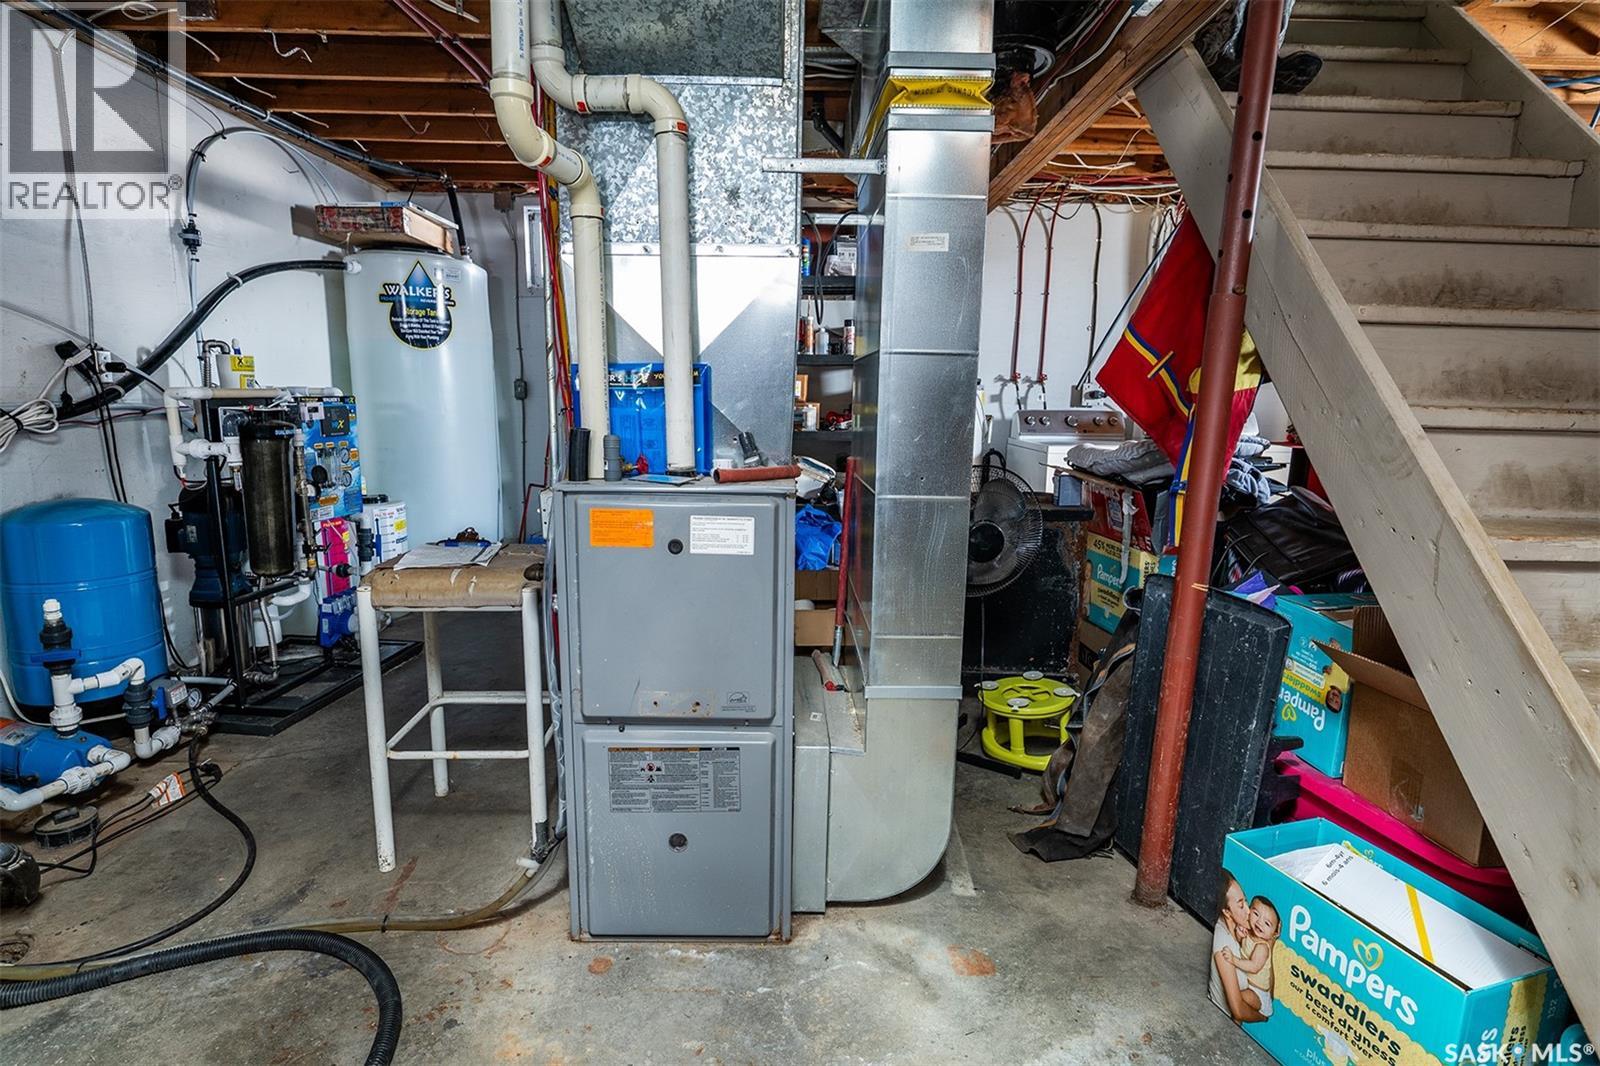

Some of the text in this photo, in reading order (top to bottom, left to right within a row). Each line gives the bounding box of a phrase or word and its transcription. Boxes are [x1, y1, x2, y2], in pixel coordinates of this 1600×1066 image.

[385, 285, 450, 299] WALKERS
[1097, 563, 1122, 588] Pamper
[1279, 687, 1326, 731] Pamper
[1289, 905, 1418, 1026] Pampers
[1290, 965, 1401, 1056] swaddlers
[1290, 981, 1304, 995] our
[1305, 990, 1335, 1020] best
[1338, 1017, 1397, 1066] dryness
[1311, 1008, 1350, 1041] comfort
[1351, 1039, 1374, 1060] ever
